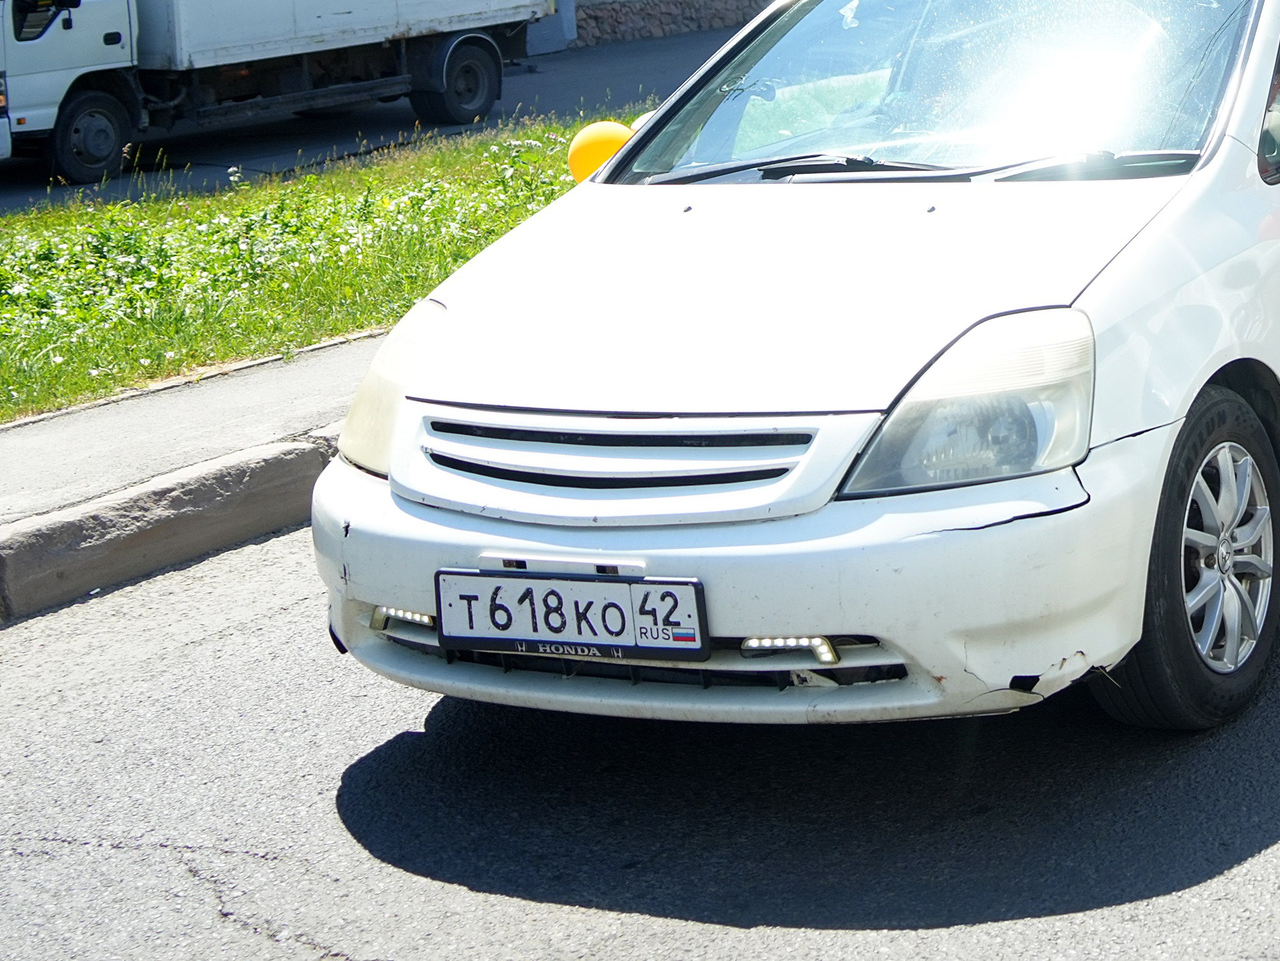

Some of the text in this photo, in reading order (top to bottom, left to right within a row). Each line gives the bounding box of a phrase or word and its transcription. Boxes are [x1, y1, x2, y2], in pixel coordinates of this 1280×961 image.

[458, 585, 682, 637] Т618КО 42
[639, 626, 671, 641] RUS
[537, 643, 602, 657] HONDA
